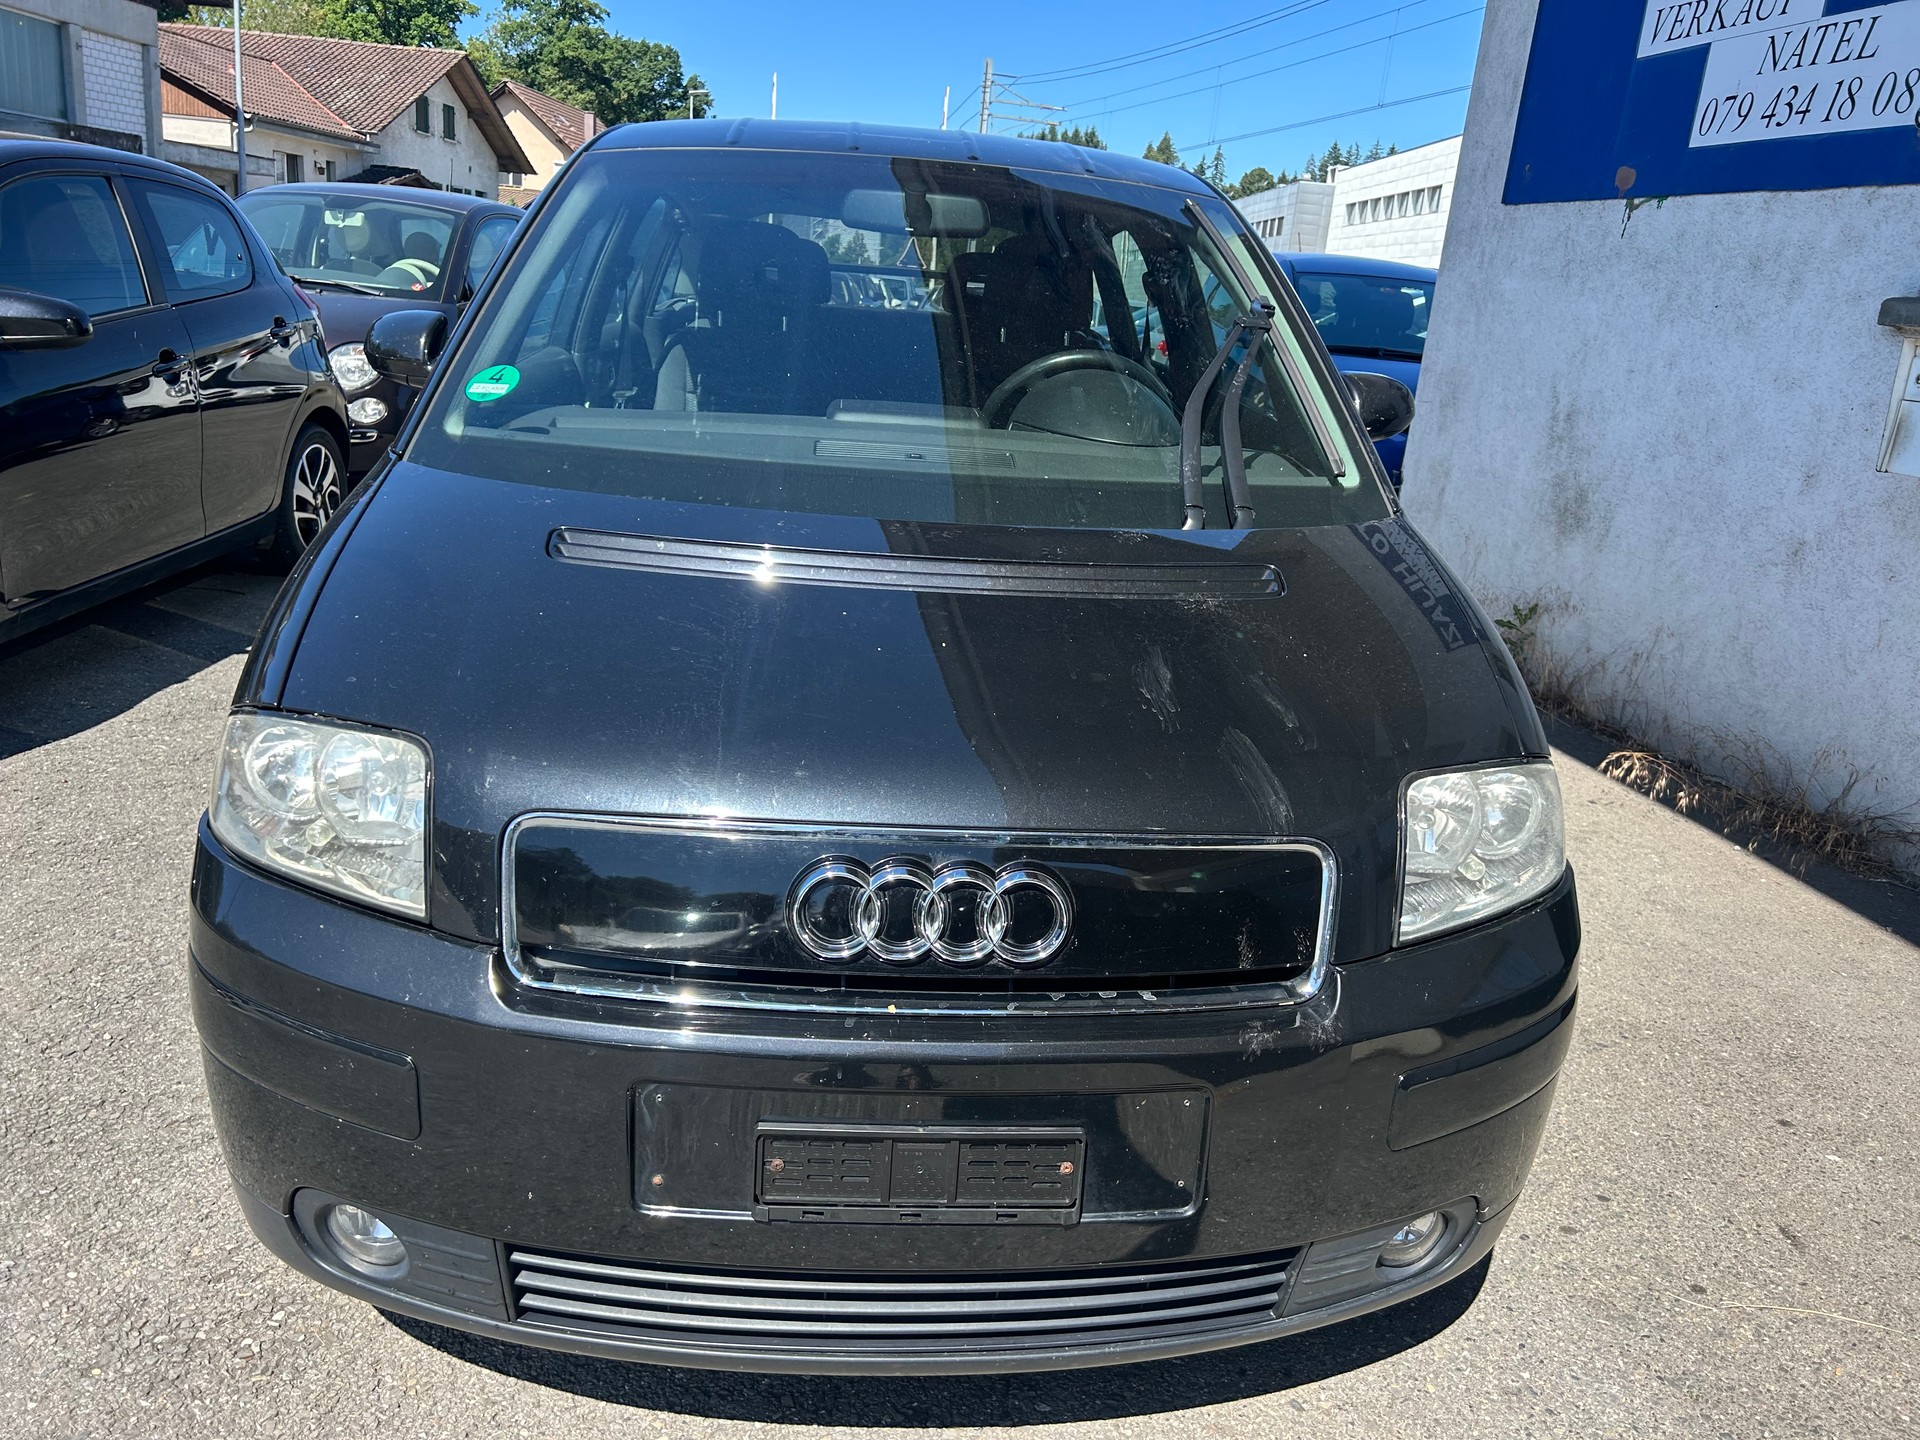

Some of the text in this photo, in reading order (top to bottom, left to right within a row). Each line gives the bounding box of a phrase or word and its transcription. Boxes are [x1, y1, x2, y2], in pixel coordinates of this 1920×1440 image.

[1756, 15, 1882, 76] NATEL
[1699, 67, 1920, 136] 079 434 18 08
[488, 366, 508, 383] 4
